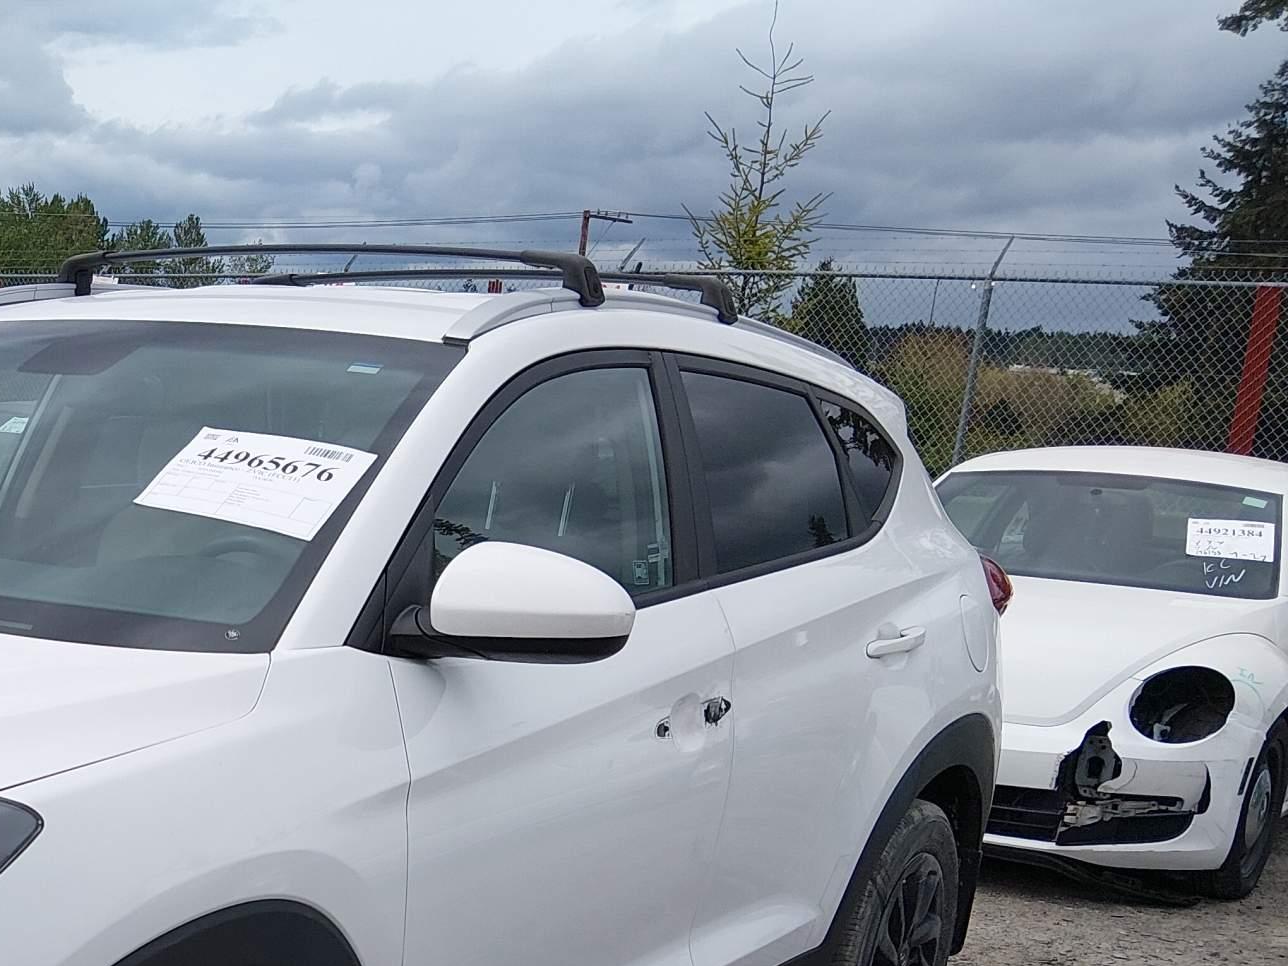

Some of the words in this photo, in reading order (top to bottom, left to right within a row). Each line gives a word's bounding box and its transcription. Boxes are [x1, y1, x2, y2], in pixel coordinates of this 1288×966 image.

[197, 447, 340, 482] 44965676
[1194, 527, 1264, 538] 44921384
[1205, 569, 1246, 589] VIN
